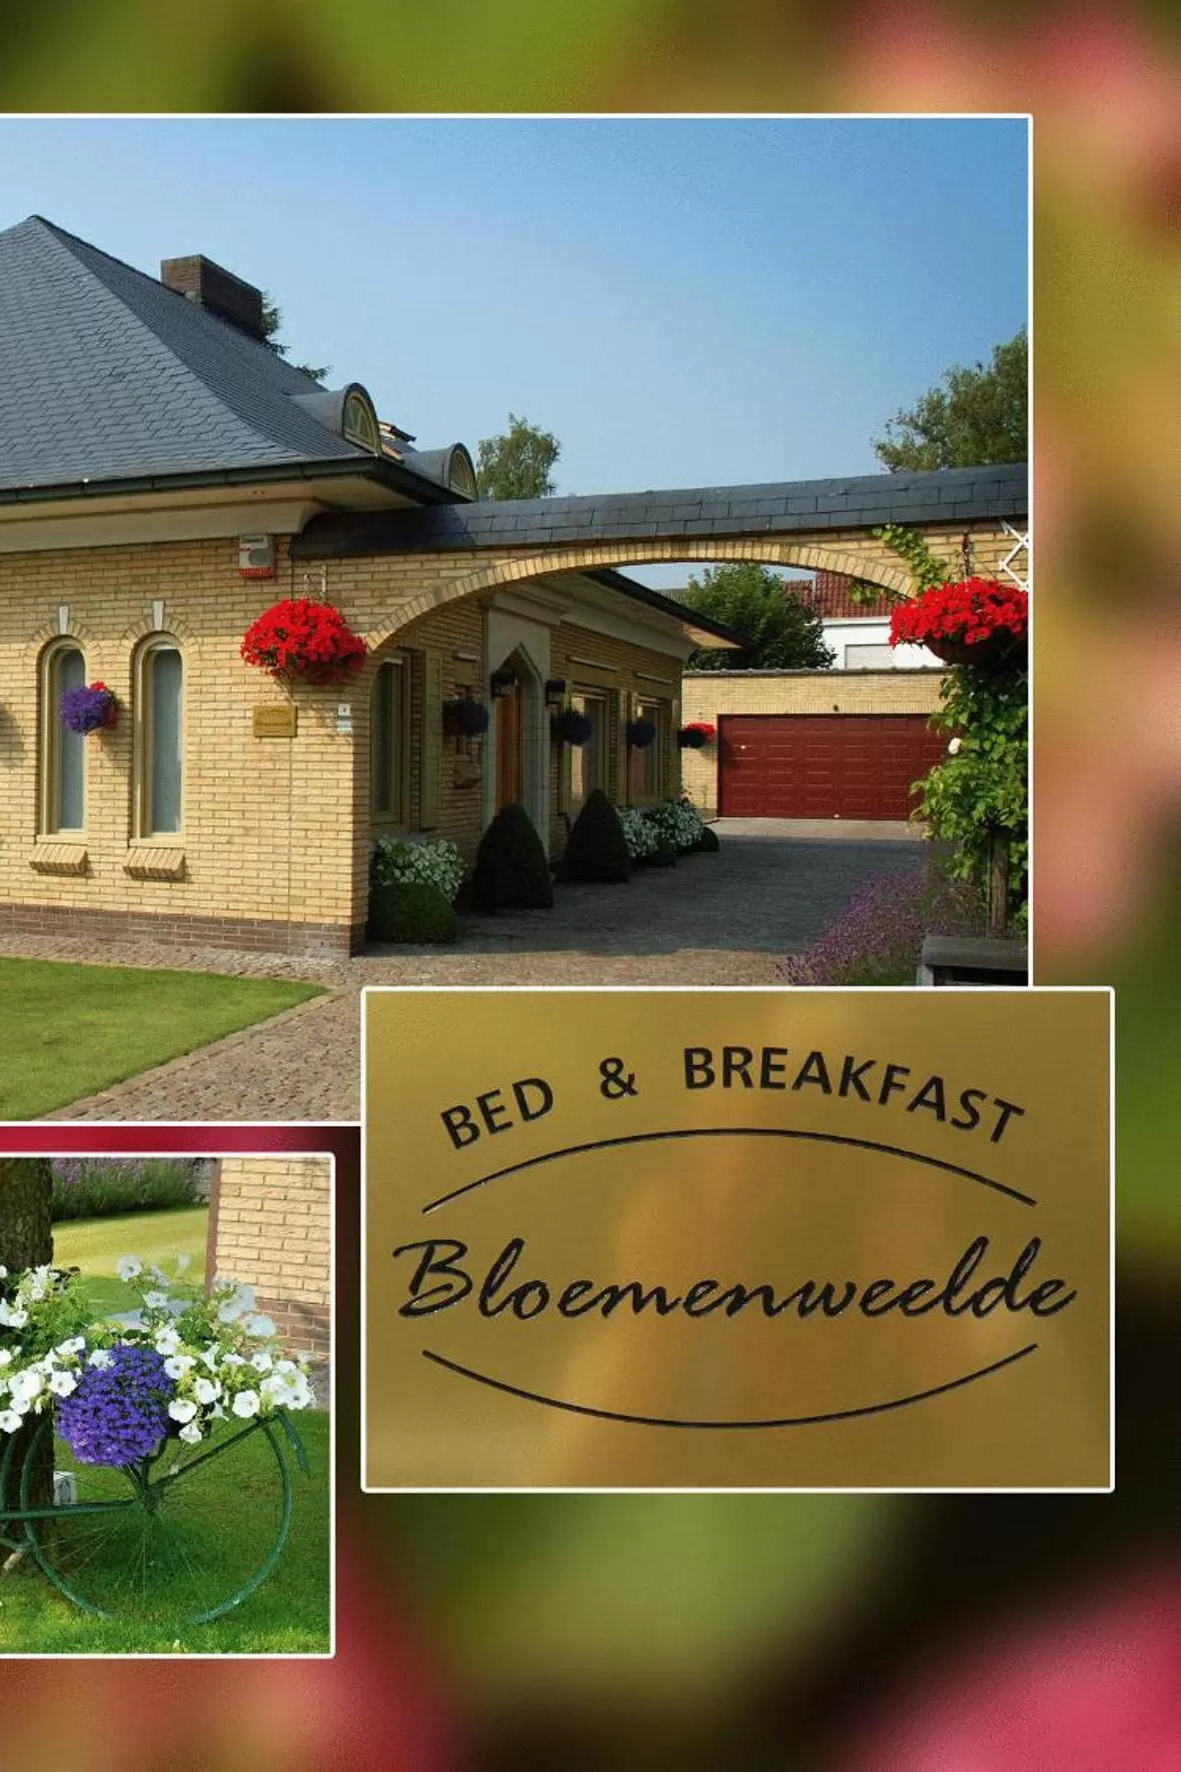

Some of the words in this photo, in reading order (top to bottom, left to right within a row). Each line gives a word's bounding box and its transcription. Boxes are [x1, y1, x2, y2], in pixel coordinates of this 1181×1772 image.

[440, 1078, 554, 1150] BED
[599, 1057, 639, 1100] &
[684, 1046, 1026, 1143] BREAKFAST
[392, 1235, 1078, 1320] Bloemenweelde
